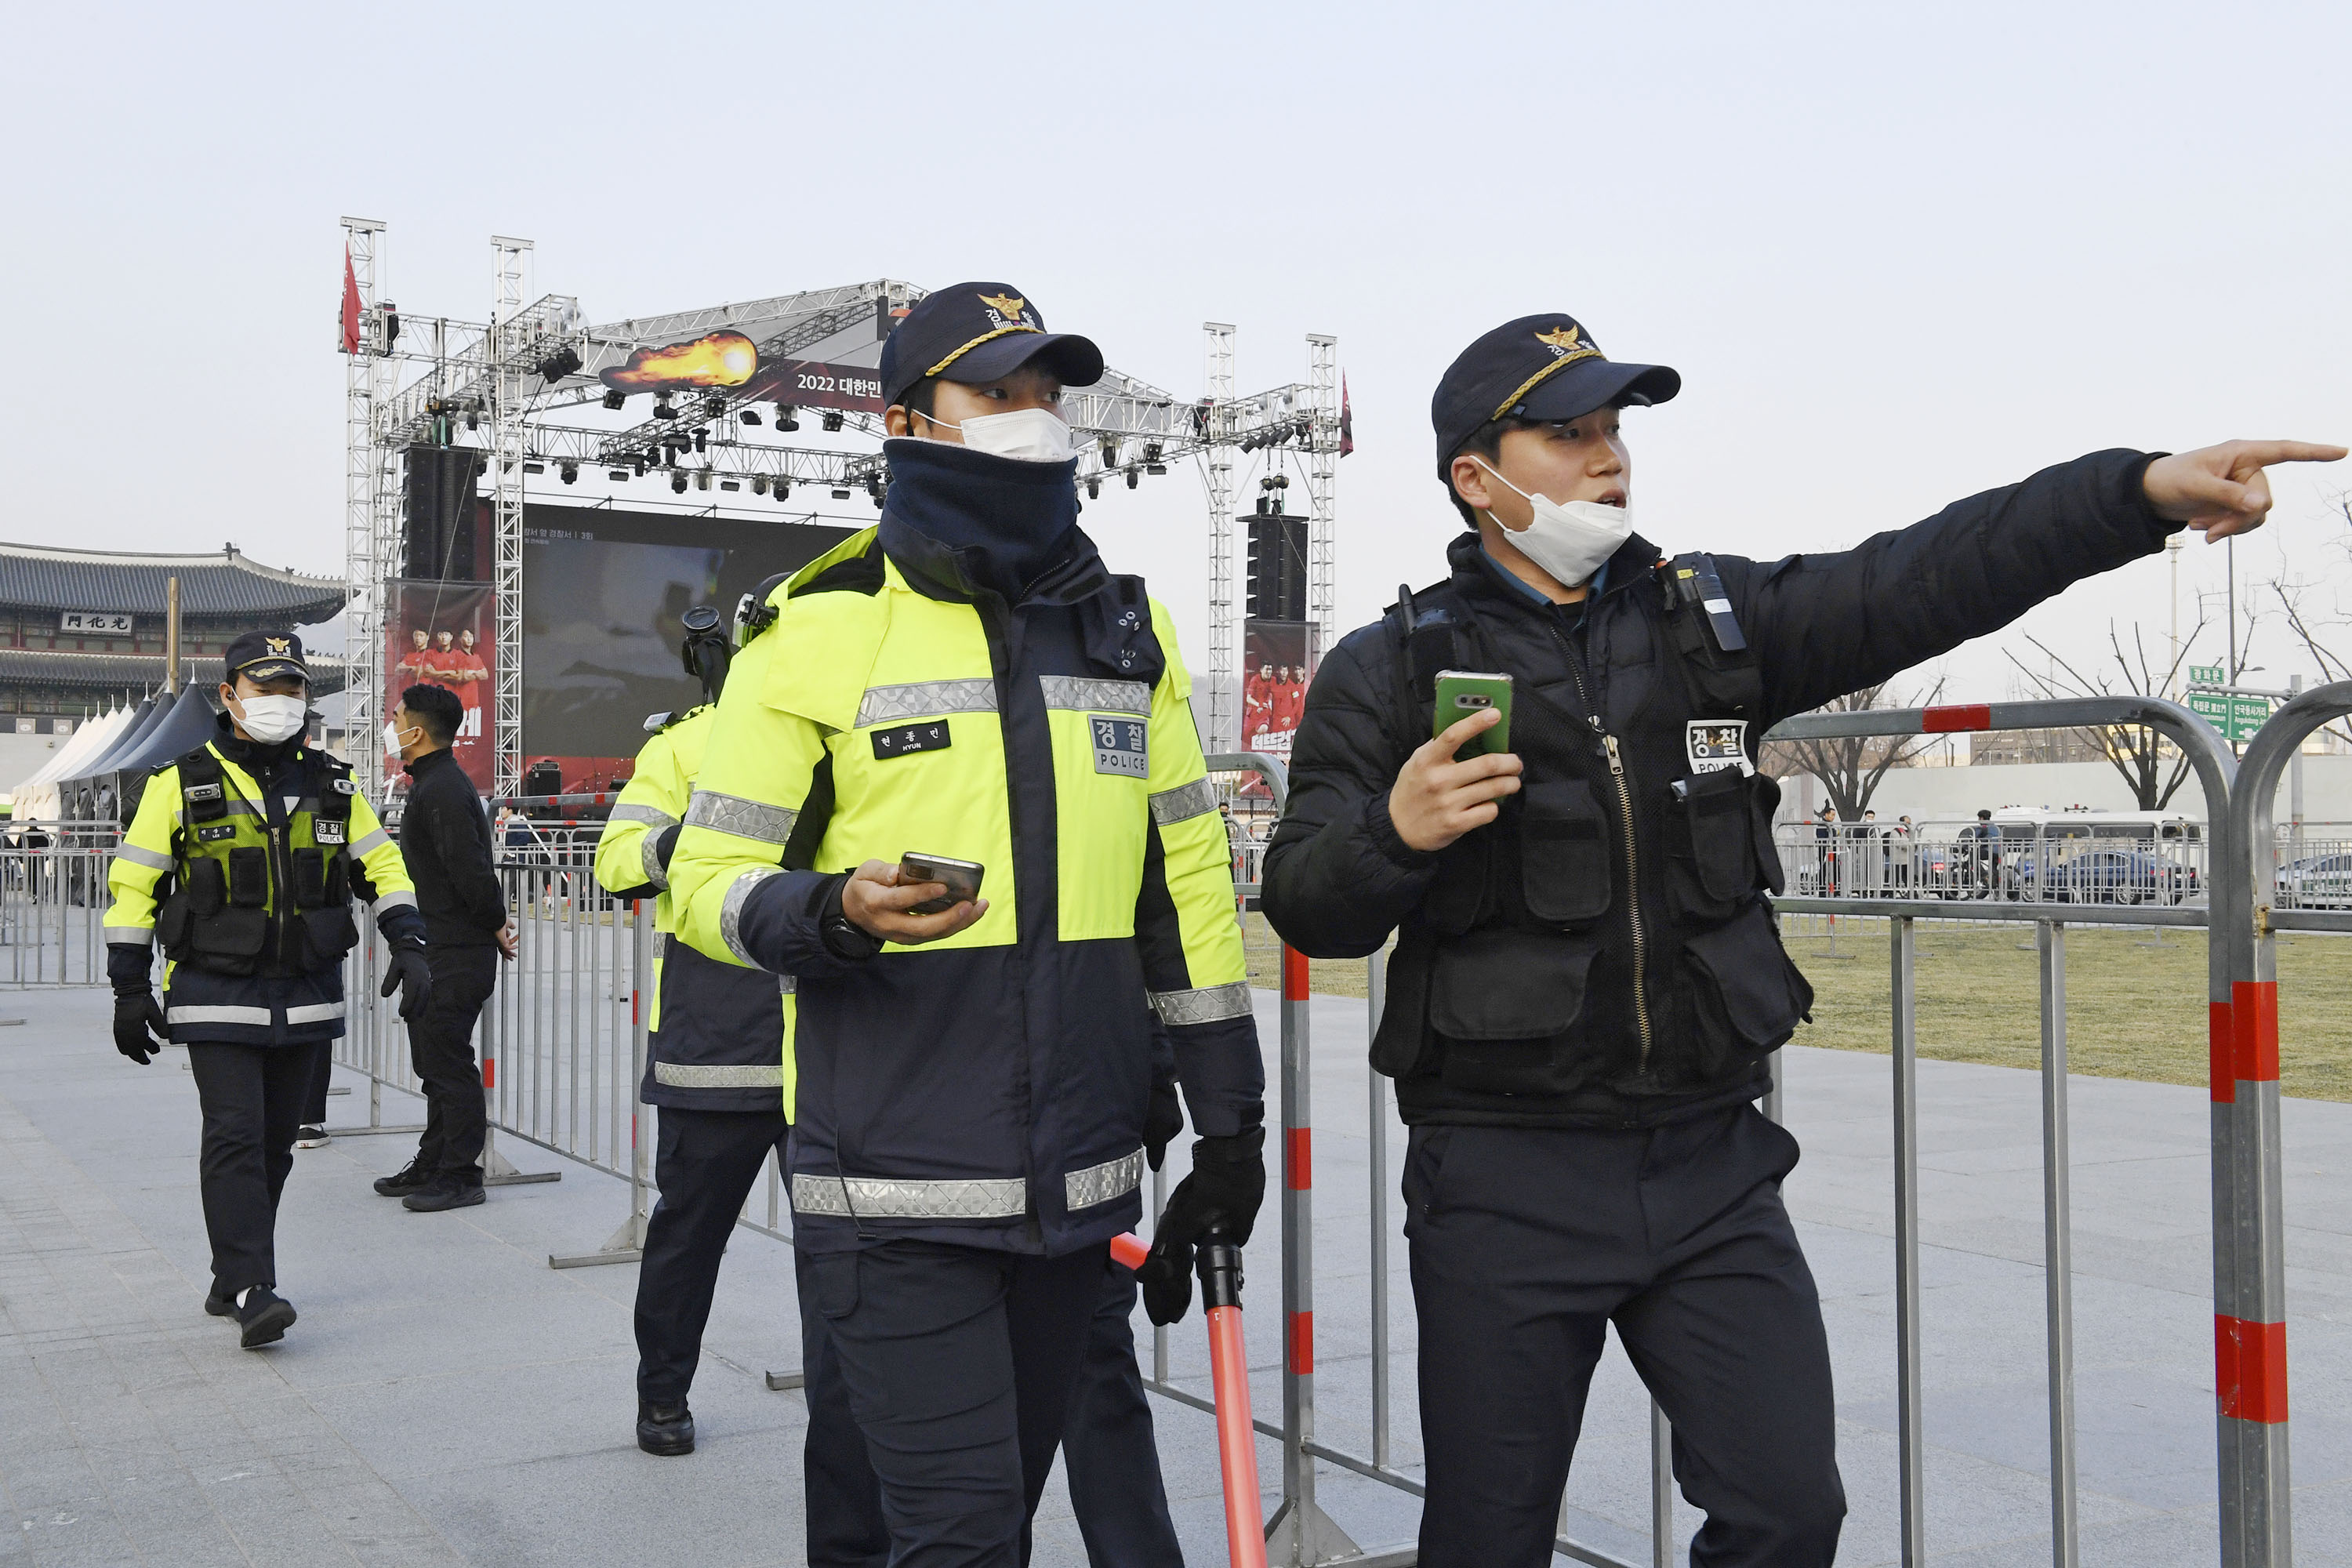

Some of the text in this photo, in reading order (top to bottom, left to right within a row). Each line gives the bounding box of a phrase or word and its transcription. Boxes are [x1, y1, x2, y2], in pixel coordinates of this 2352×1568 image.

[797, 374, 881, 398] 2022 대한민
[2194, 669, 2220, 681] 광화문
[2234, 704, 2267, 717] 안국동사거리
[1096, 721, 1144, 752] 경찰
[1692, 728, 1739, 757] 경찰
[902, 742, 922, 752] HYUN
[1100, 753, 1145, 771] POLICE
[318, 822, 339, 833] 경찰
[318, 834, 341, 843] POLICE
